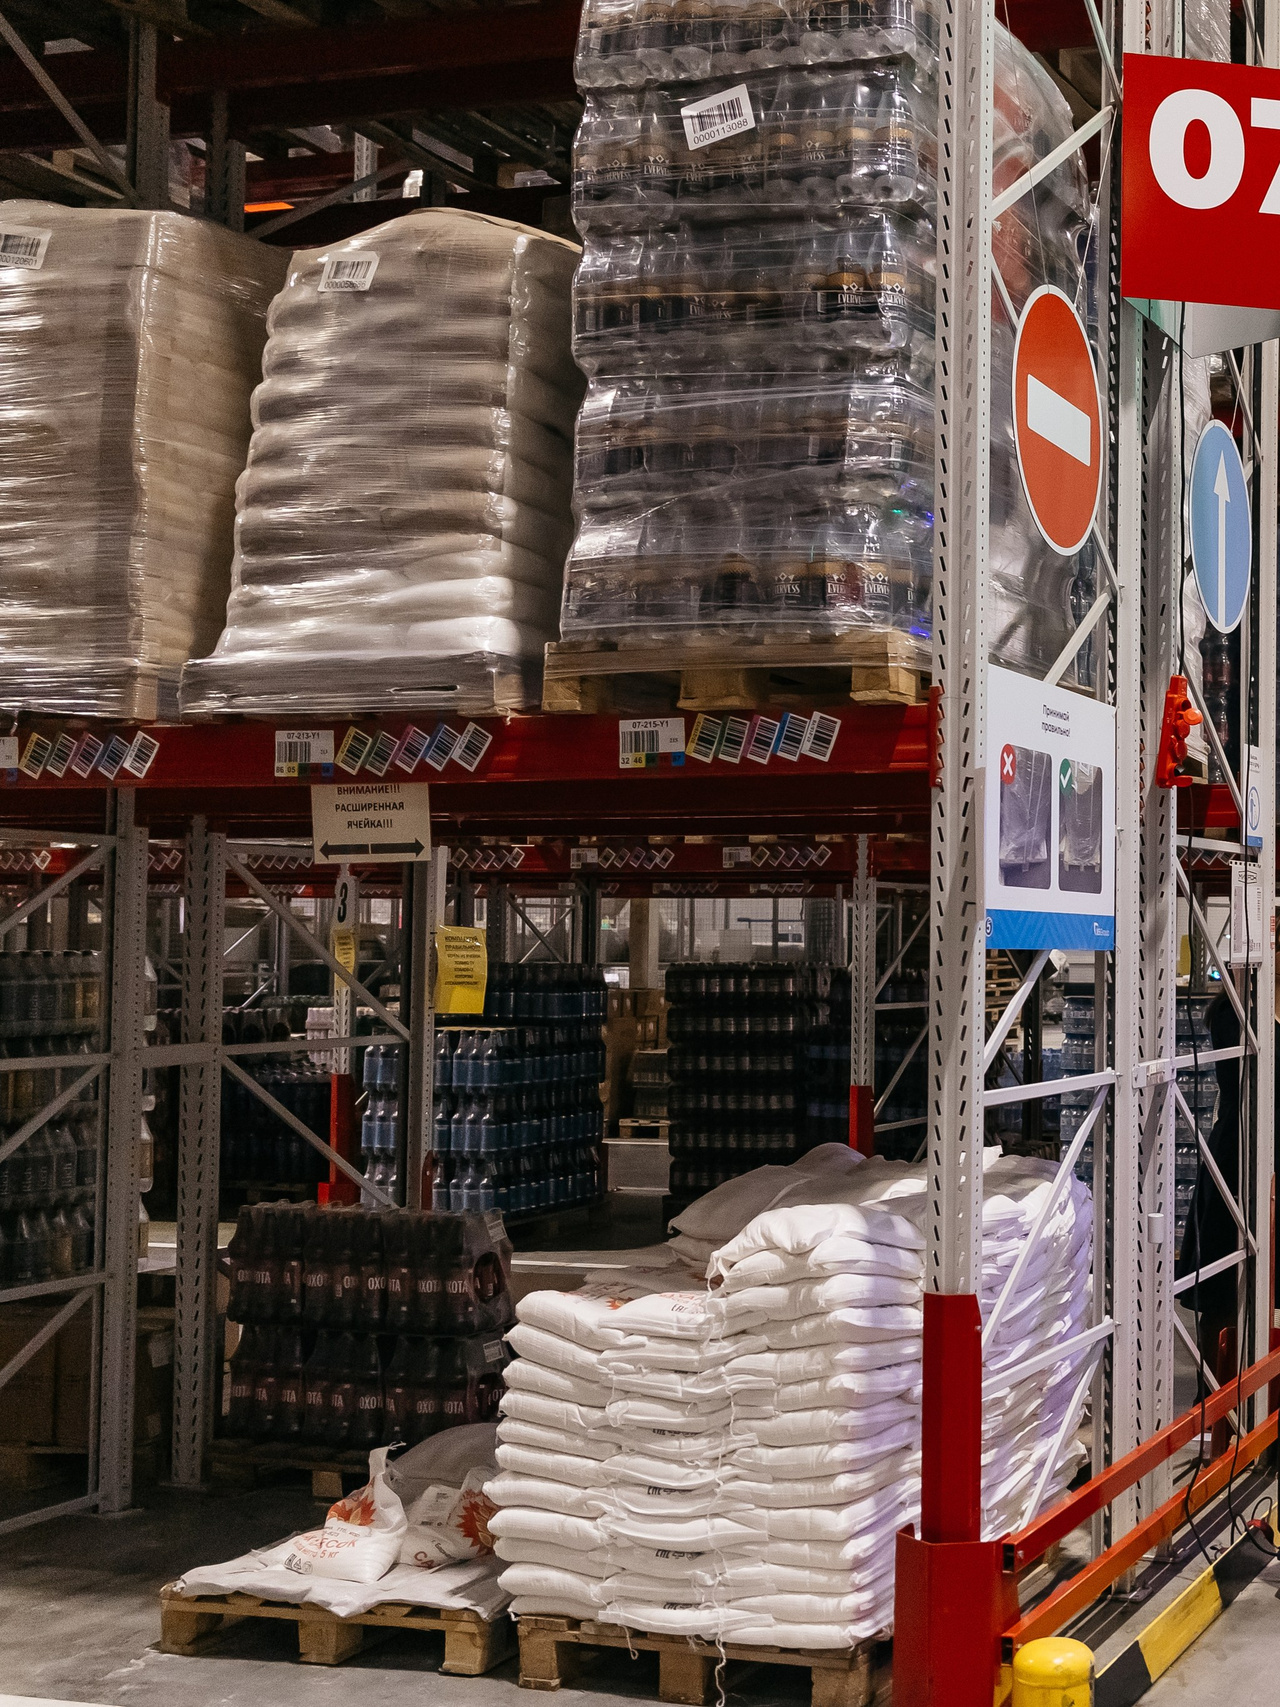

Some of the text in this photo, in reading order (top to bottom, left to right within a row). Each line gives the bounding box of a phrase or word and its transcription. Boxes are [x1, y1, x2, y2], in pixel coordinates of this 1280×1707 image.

[693, 117, 749, 145] 0000113088
[632, 720, 669, 729] 07-215-Y1
[286, 732, 320, 740] 07-213-Y1
[621, 757, 630, 765] 32
[633, 756, 643, 764] 46
[337, 785, 401, 795] ВНИМАНИЕ!!!
[335, 801, 405, 812] РАСШИРЕННАЯ
[347, 818, 393, 829] ЯЧЕЙКА!!!
[320, 1549, 327, 1559] 5
